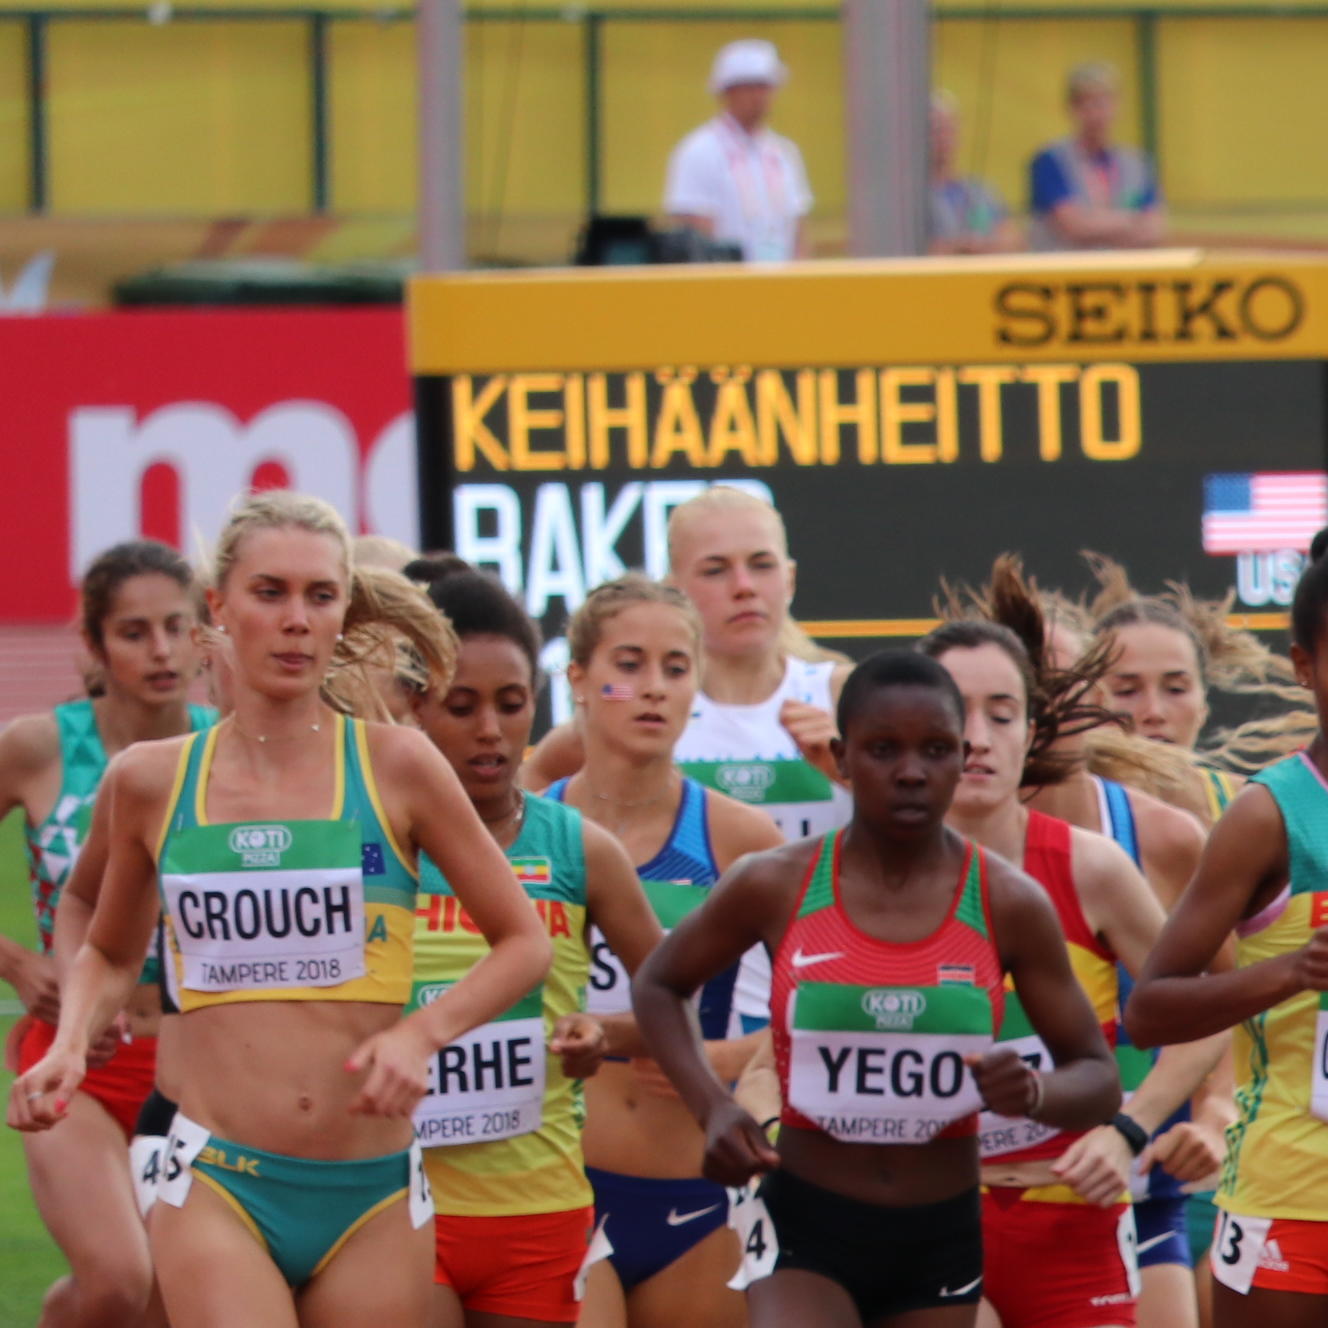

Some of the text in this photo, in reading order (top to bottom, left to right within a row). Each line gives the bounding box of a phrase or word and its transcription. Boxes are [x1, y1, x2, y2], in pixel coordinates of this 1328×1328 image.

[993, 275, 1306, 347] SEIKO
[452, 363, 1143, 472] KEIHÄÄNHEITTO
[452, 478, 776, 620] BAKE
[1236, 550, 1312, 606] US
[178, 886, 352, 941] CROUCH
[202, 958, 341, 984] TAMPERE 2018
[426, 1037, 534, 1097] RHE
[817, 1046, 964, 1099] YEGO
[482, 1110, 520, 1135] 2018
[816, 1116, 907, 1138] TAMPERE
